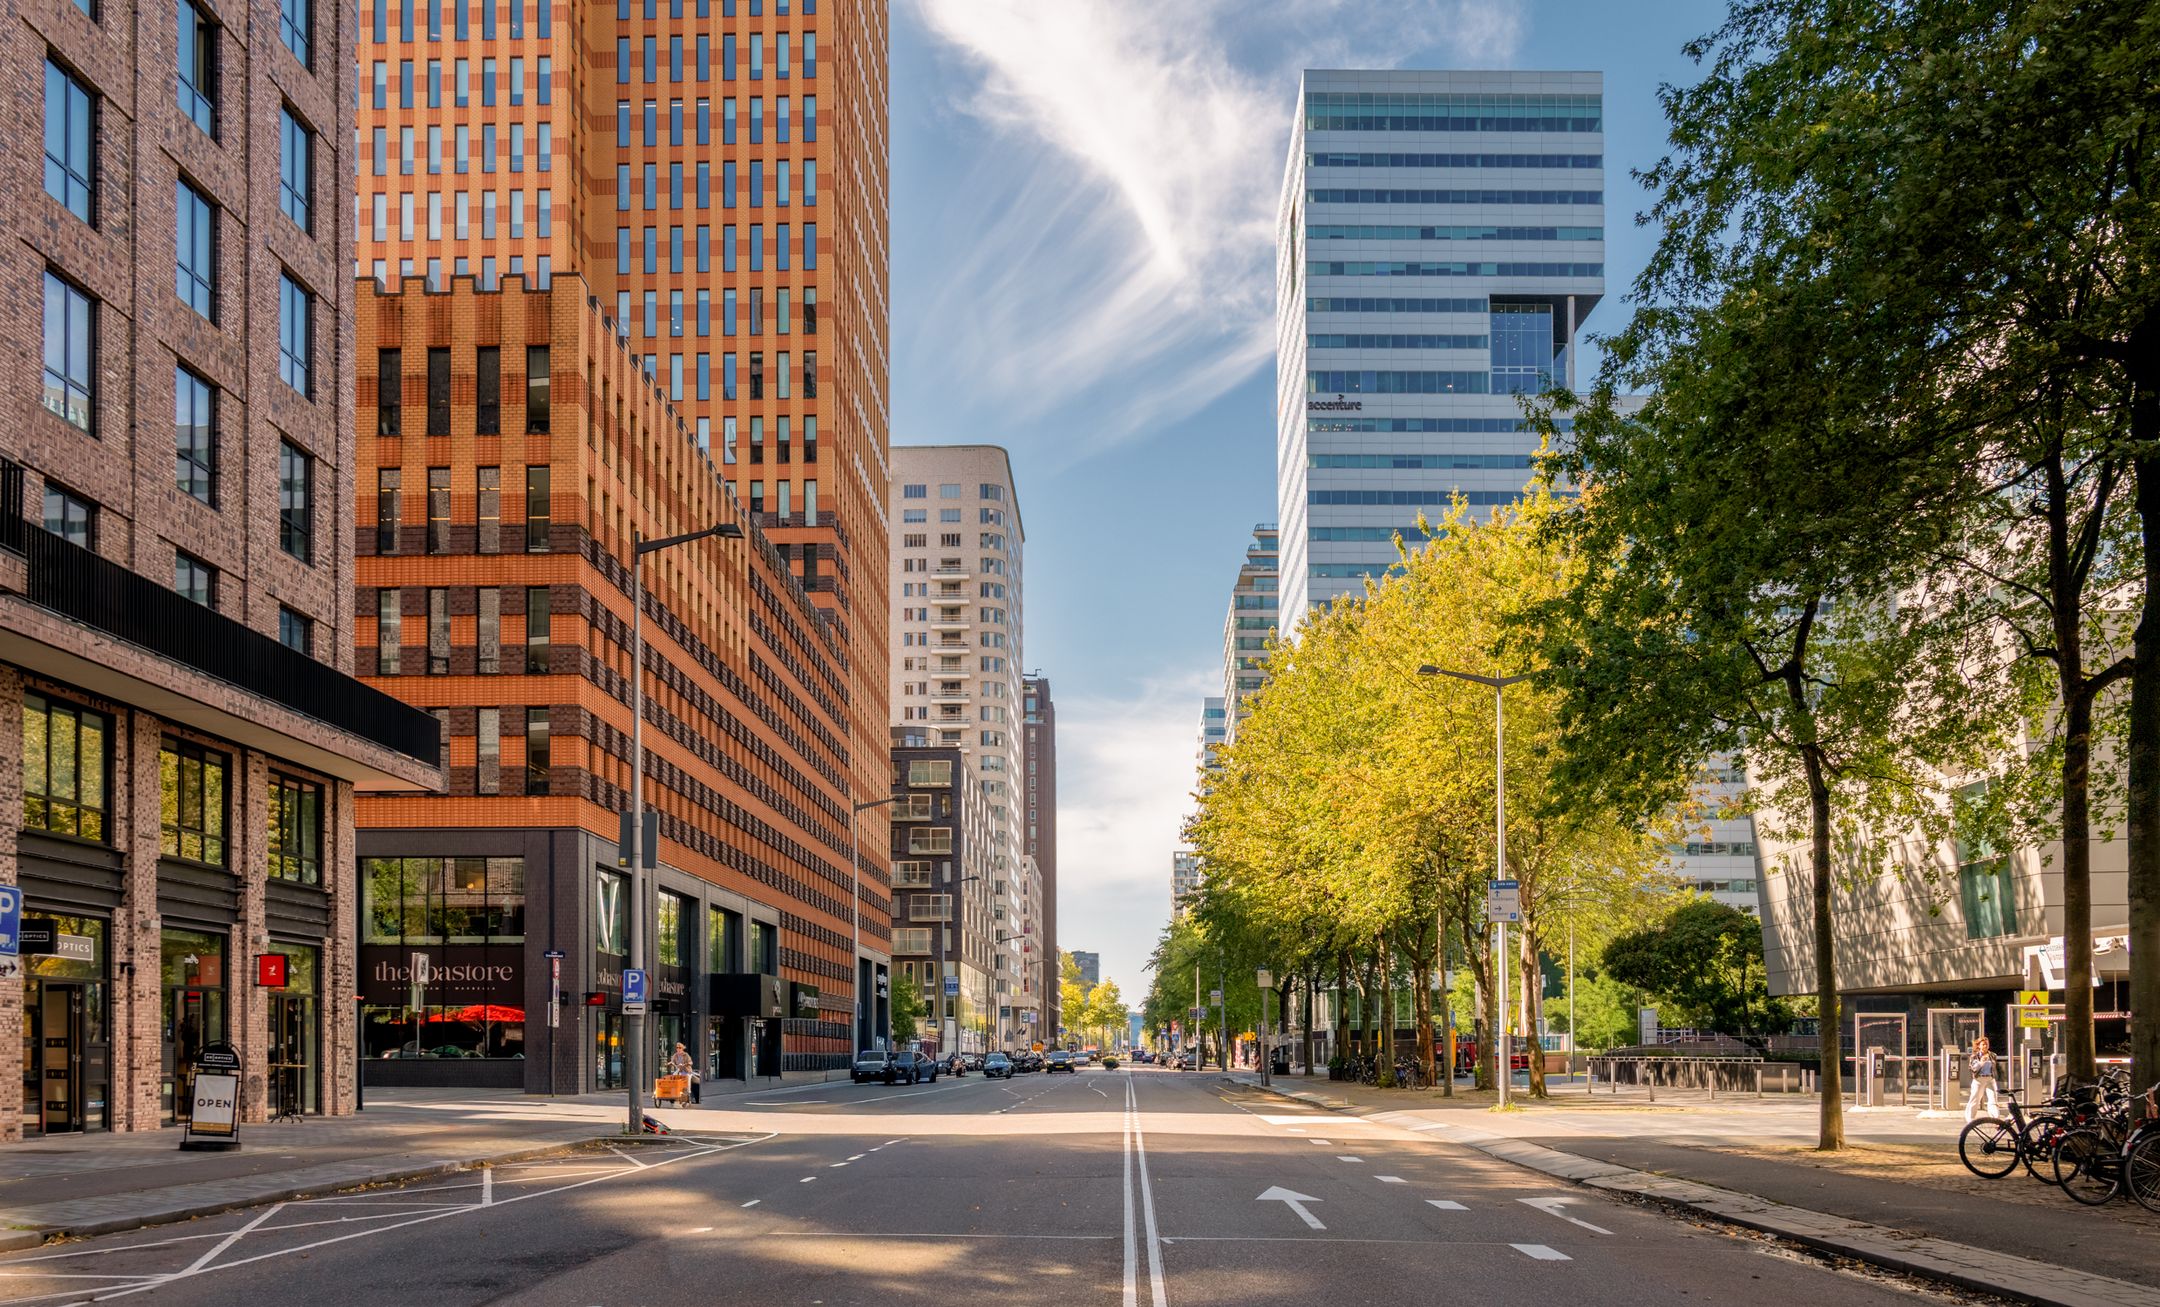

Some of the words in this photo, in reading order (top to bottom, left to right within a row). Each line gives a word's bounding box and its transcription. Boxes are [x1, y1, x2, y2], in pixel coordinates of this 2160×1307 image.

[1307, 397, 1362, 410] accenture
[375, 961, 513, 981] thebastore
[628, 972, 641, 989] P
[197, 1098, 232, 1109] OPEN
